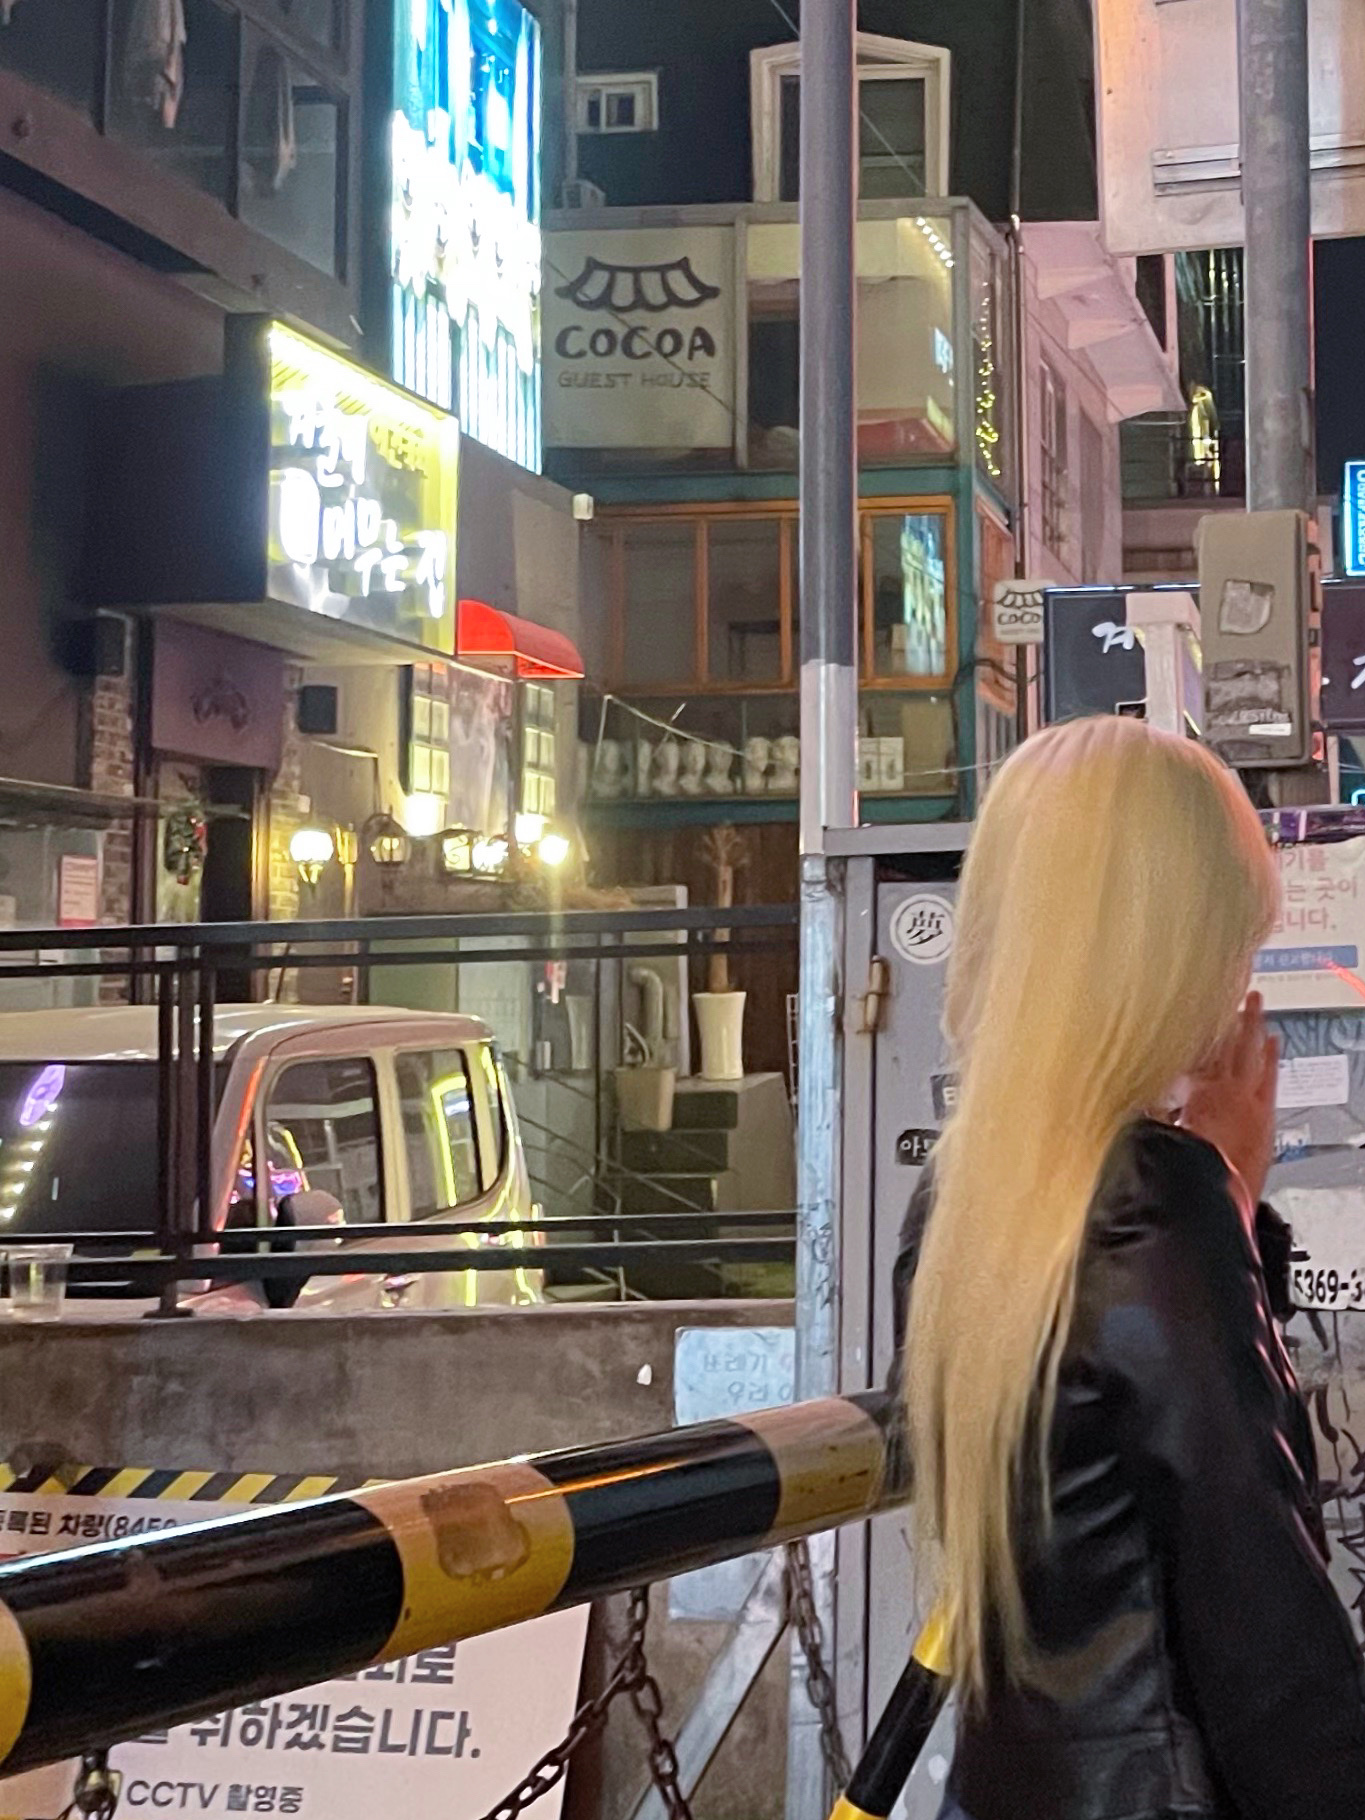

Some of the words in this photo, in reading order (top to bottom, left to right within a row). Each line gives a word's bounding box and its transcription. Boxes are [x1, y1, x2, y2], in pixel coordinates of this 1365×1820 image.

[555, 325, 715, 361] COCOA
[558, 371, 632, 388] GUEST
[641, 371, 711, 389] HOUSE
[1279, 849, 1327, 872] 기를
[1315, 876, 1358, 901] 곳이
[126, 1780, 220, 1808] CCTV
[227, 1783, 304, 1814] 촬영중
